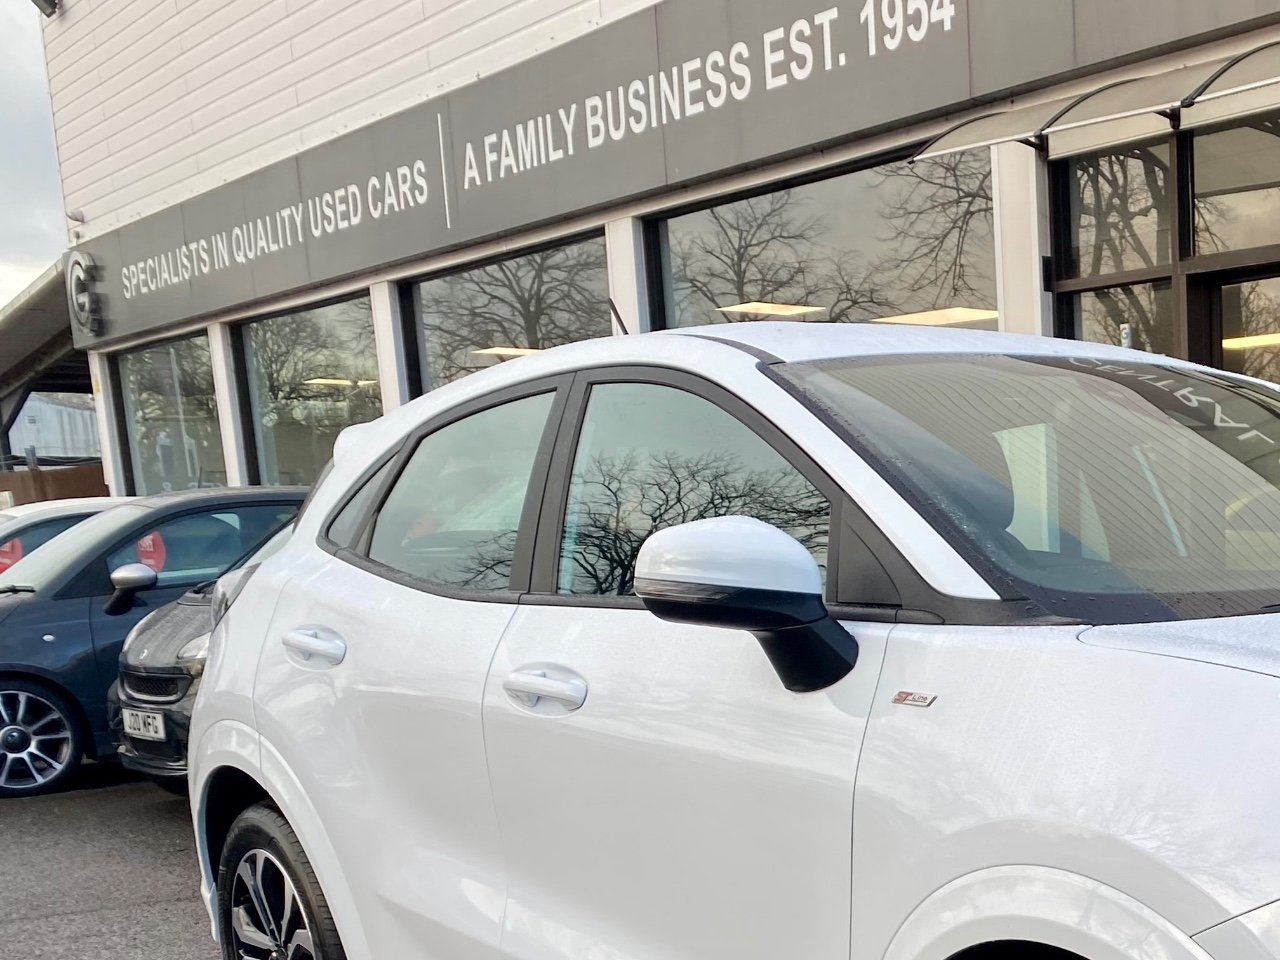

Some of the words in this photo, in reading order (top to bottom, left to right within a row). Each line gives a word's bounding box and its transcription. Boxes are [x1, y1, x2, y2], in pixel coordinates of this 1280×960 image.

[464, 142, 481, 189] A
[484, 103, 577, 182] FAMILY
[585, 41, 752, 149] BUSINESS
[763, 6, 846, 91] EST.
[859, 0, 957, 57] 1954
[121, 238, 209, 300] SPECIALISTS
[211, 231, 230, 269] IN
[232, 202, 303, 263] QUALITY
[308, 183, 362, 238] USED
[367, 159, 428, 219] CARS
